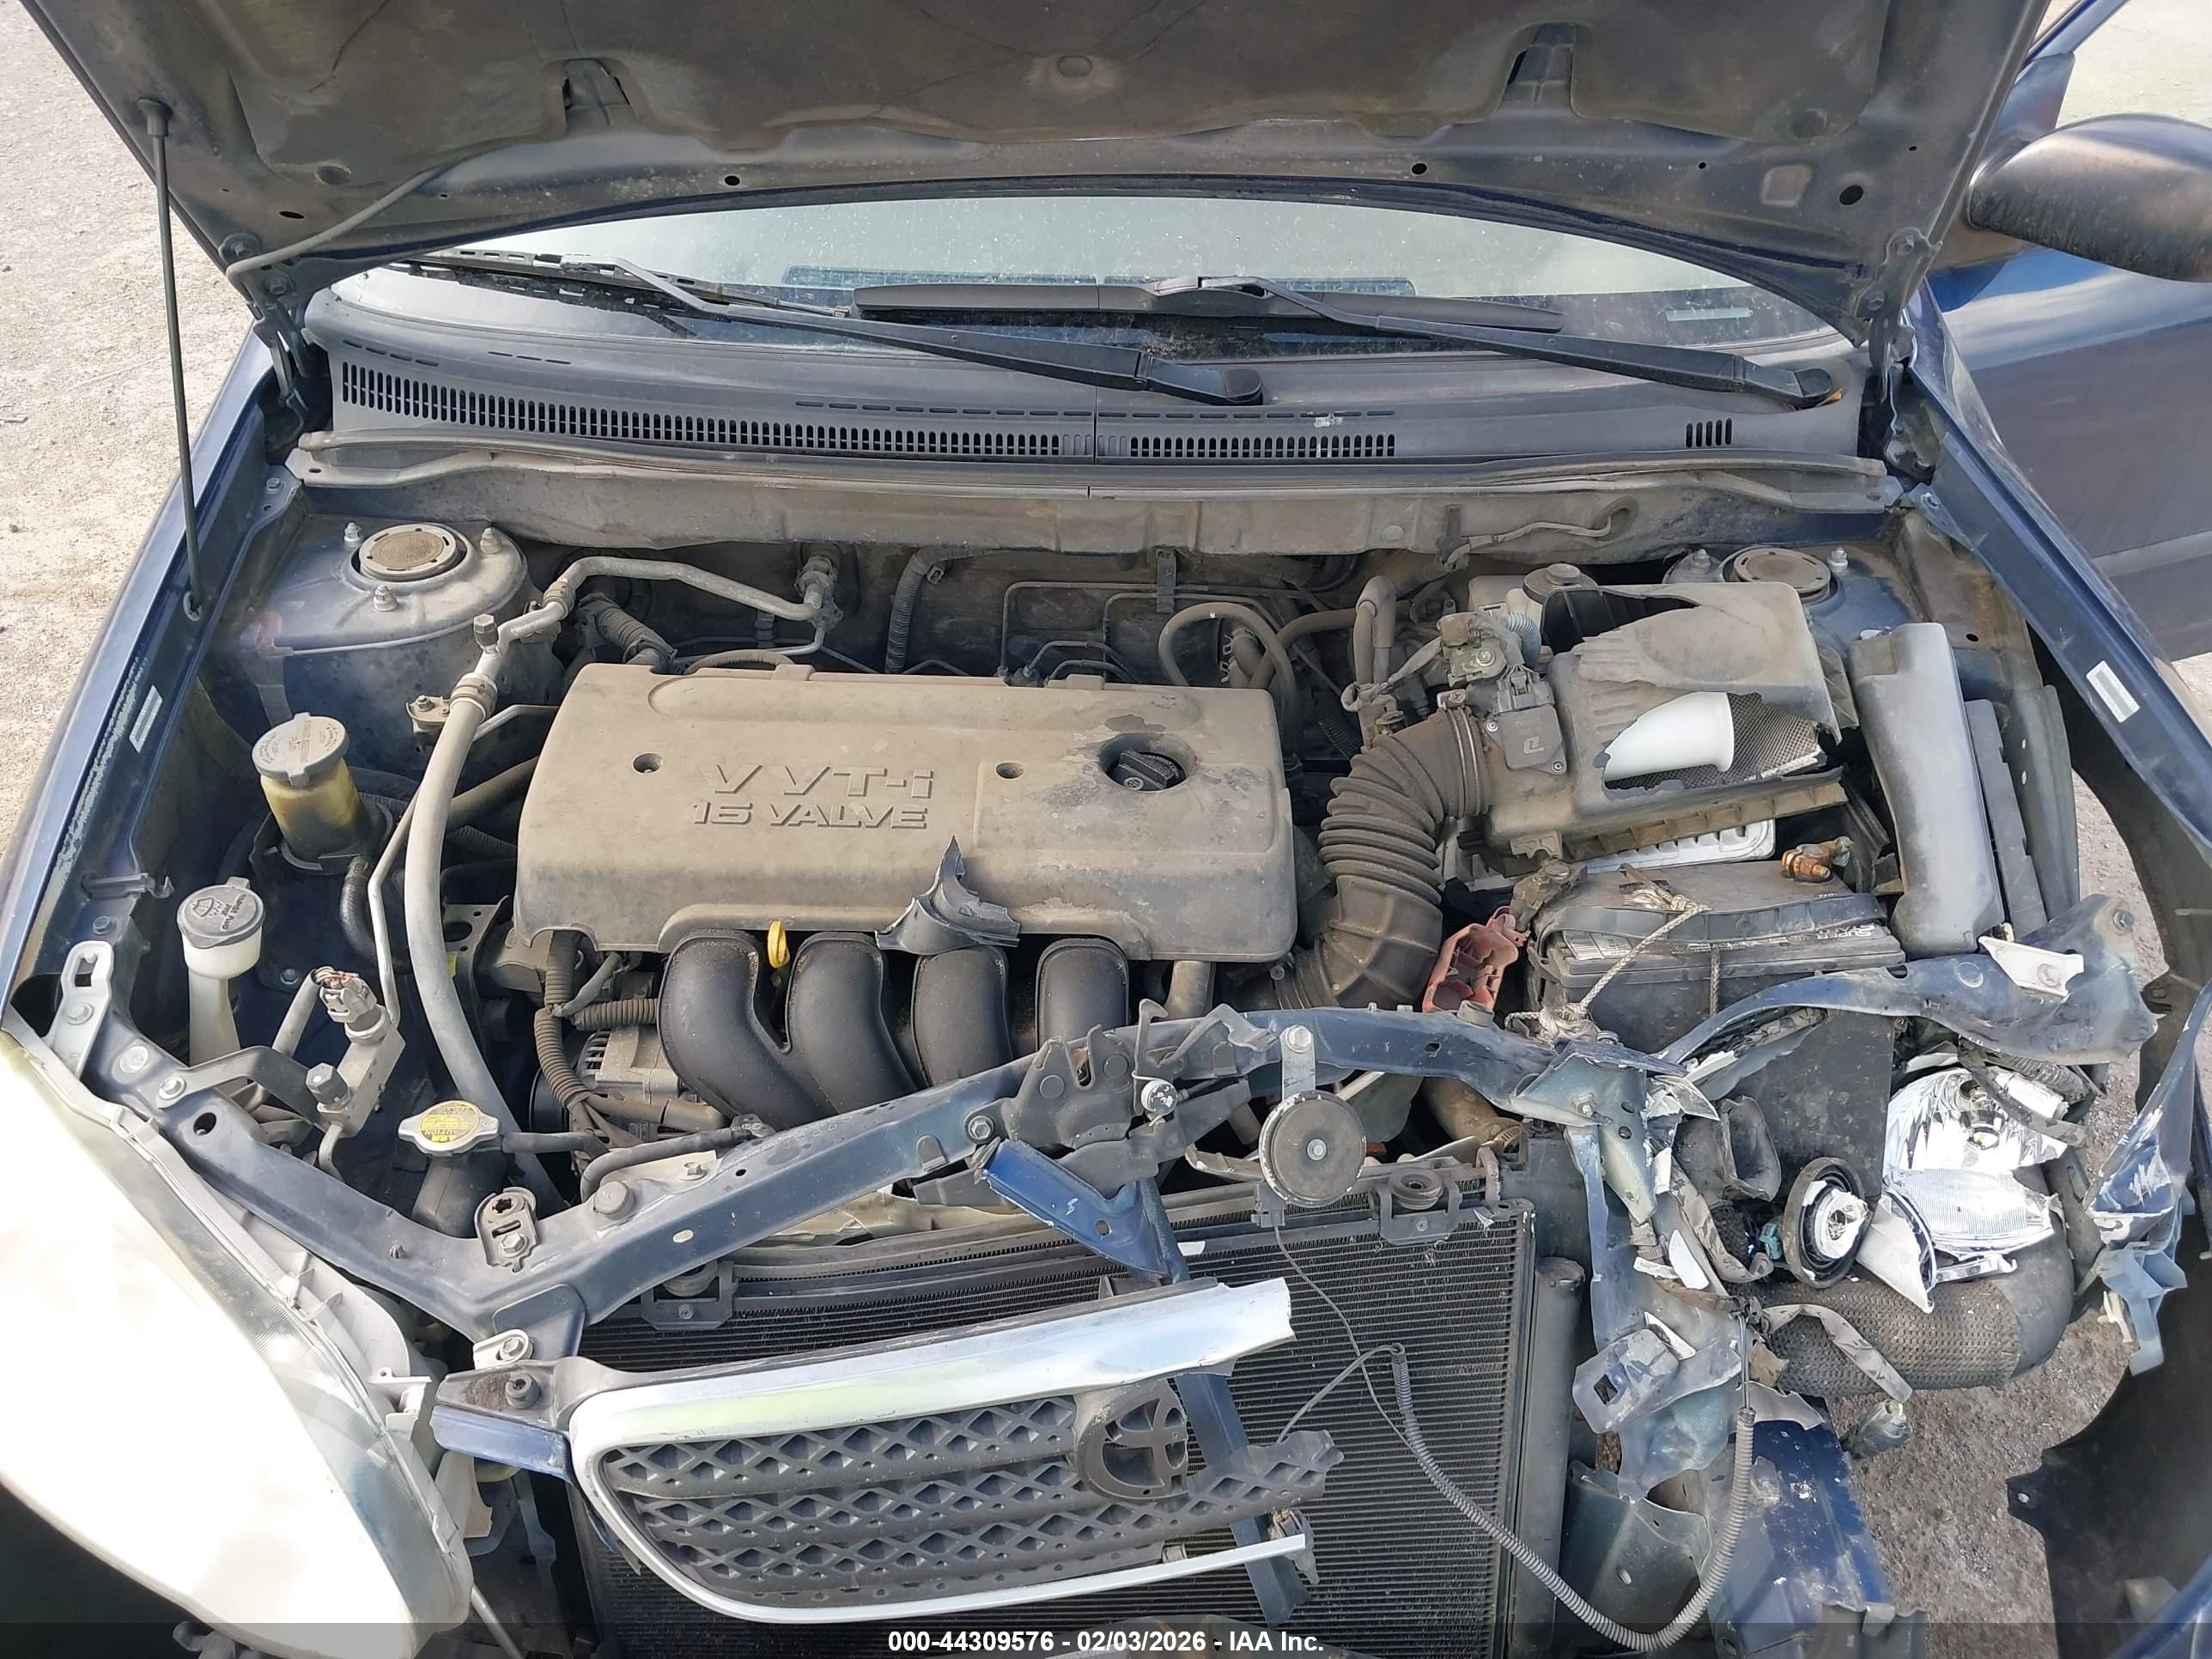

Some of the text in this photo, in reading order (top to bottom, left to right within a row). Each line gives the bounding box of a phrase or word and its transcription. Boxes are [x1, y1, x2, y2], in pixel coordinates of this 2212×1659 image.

[693, 800, 928, 830] 16 VALVE
[1817, 929, 1872, 940] SUPER
